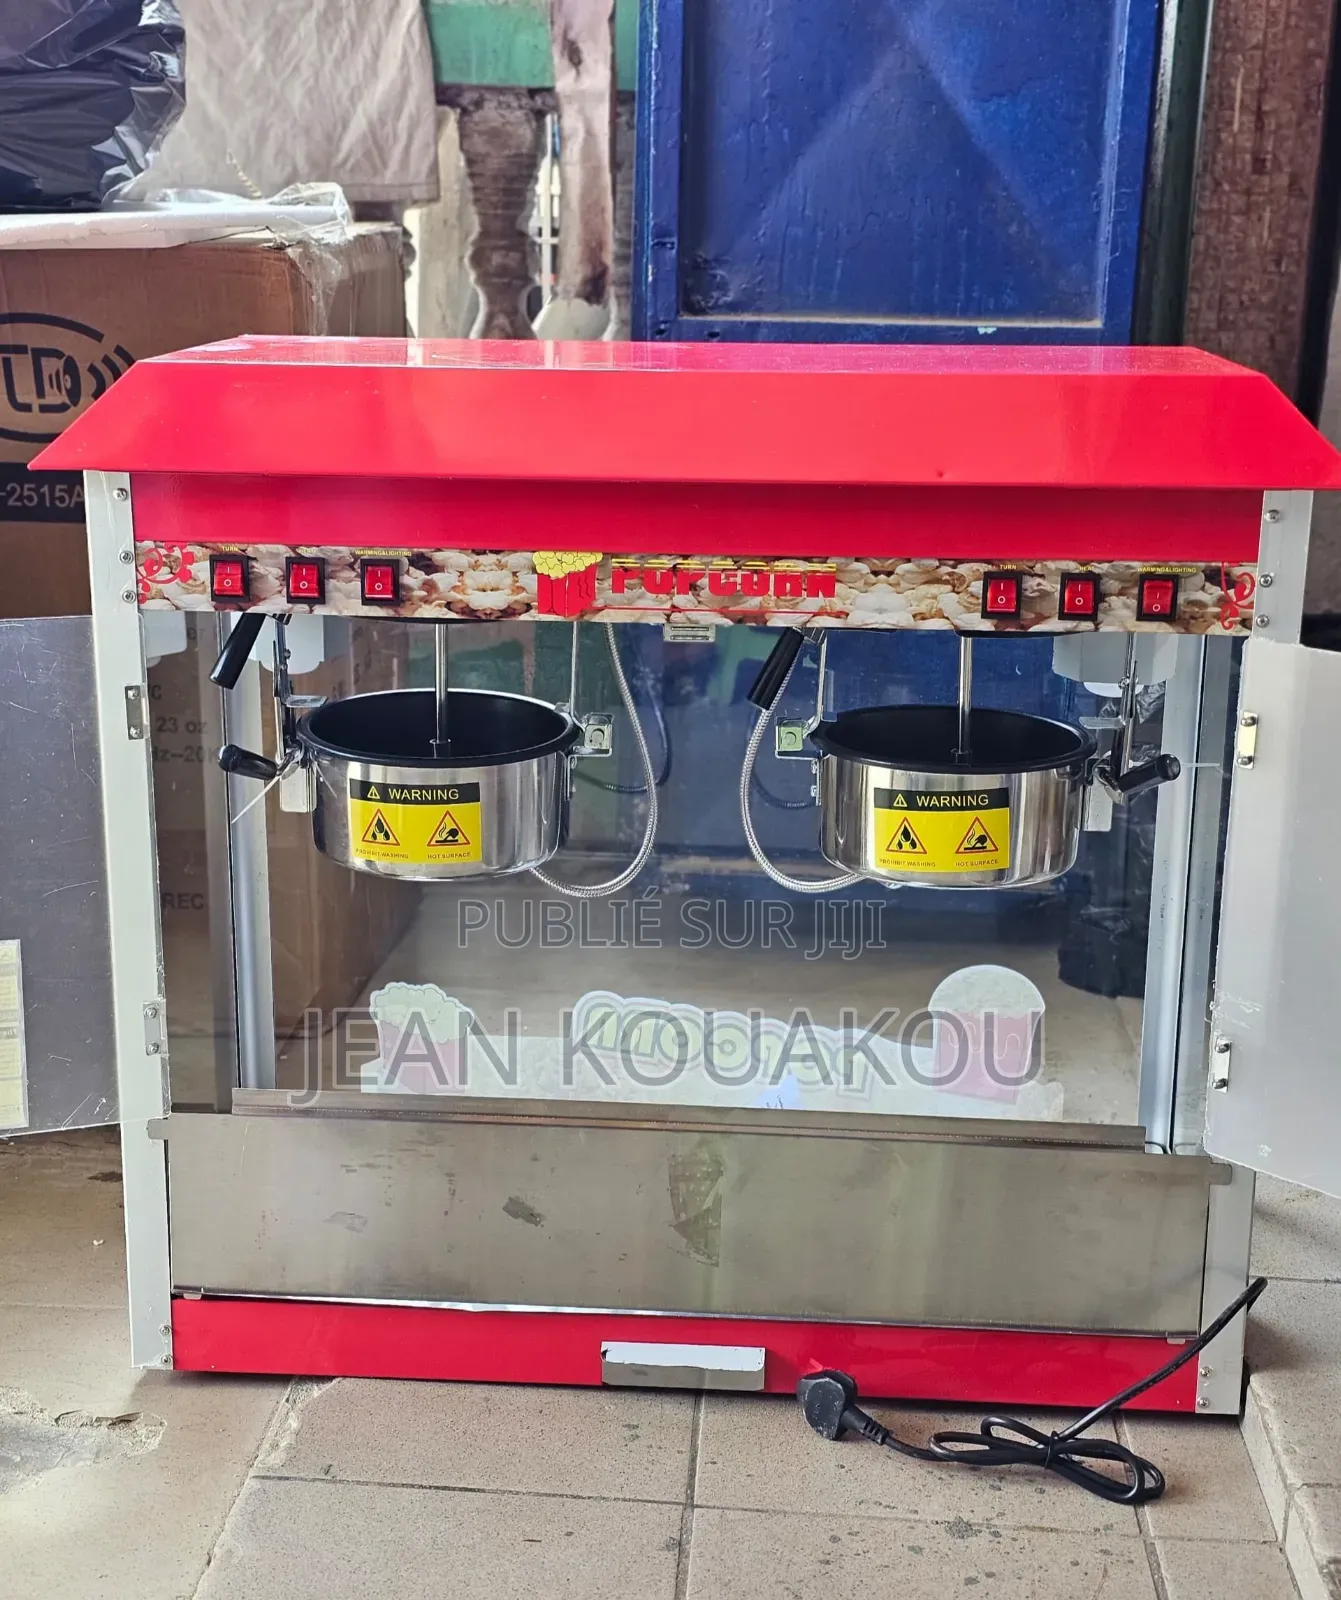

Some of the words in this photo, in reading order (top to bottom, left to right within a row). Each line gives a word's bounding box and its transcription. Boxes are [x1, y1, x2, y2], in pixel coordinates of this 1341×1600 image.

[388, 787, 459, 800] WARNING
[916, 794, 989, 807] WARNING
[970, 859, 999, 867] SURFACE
